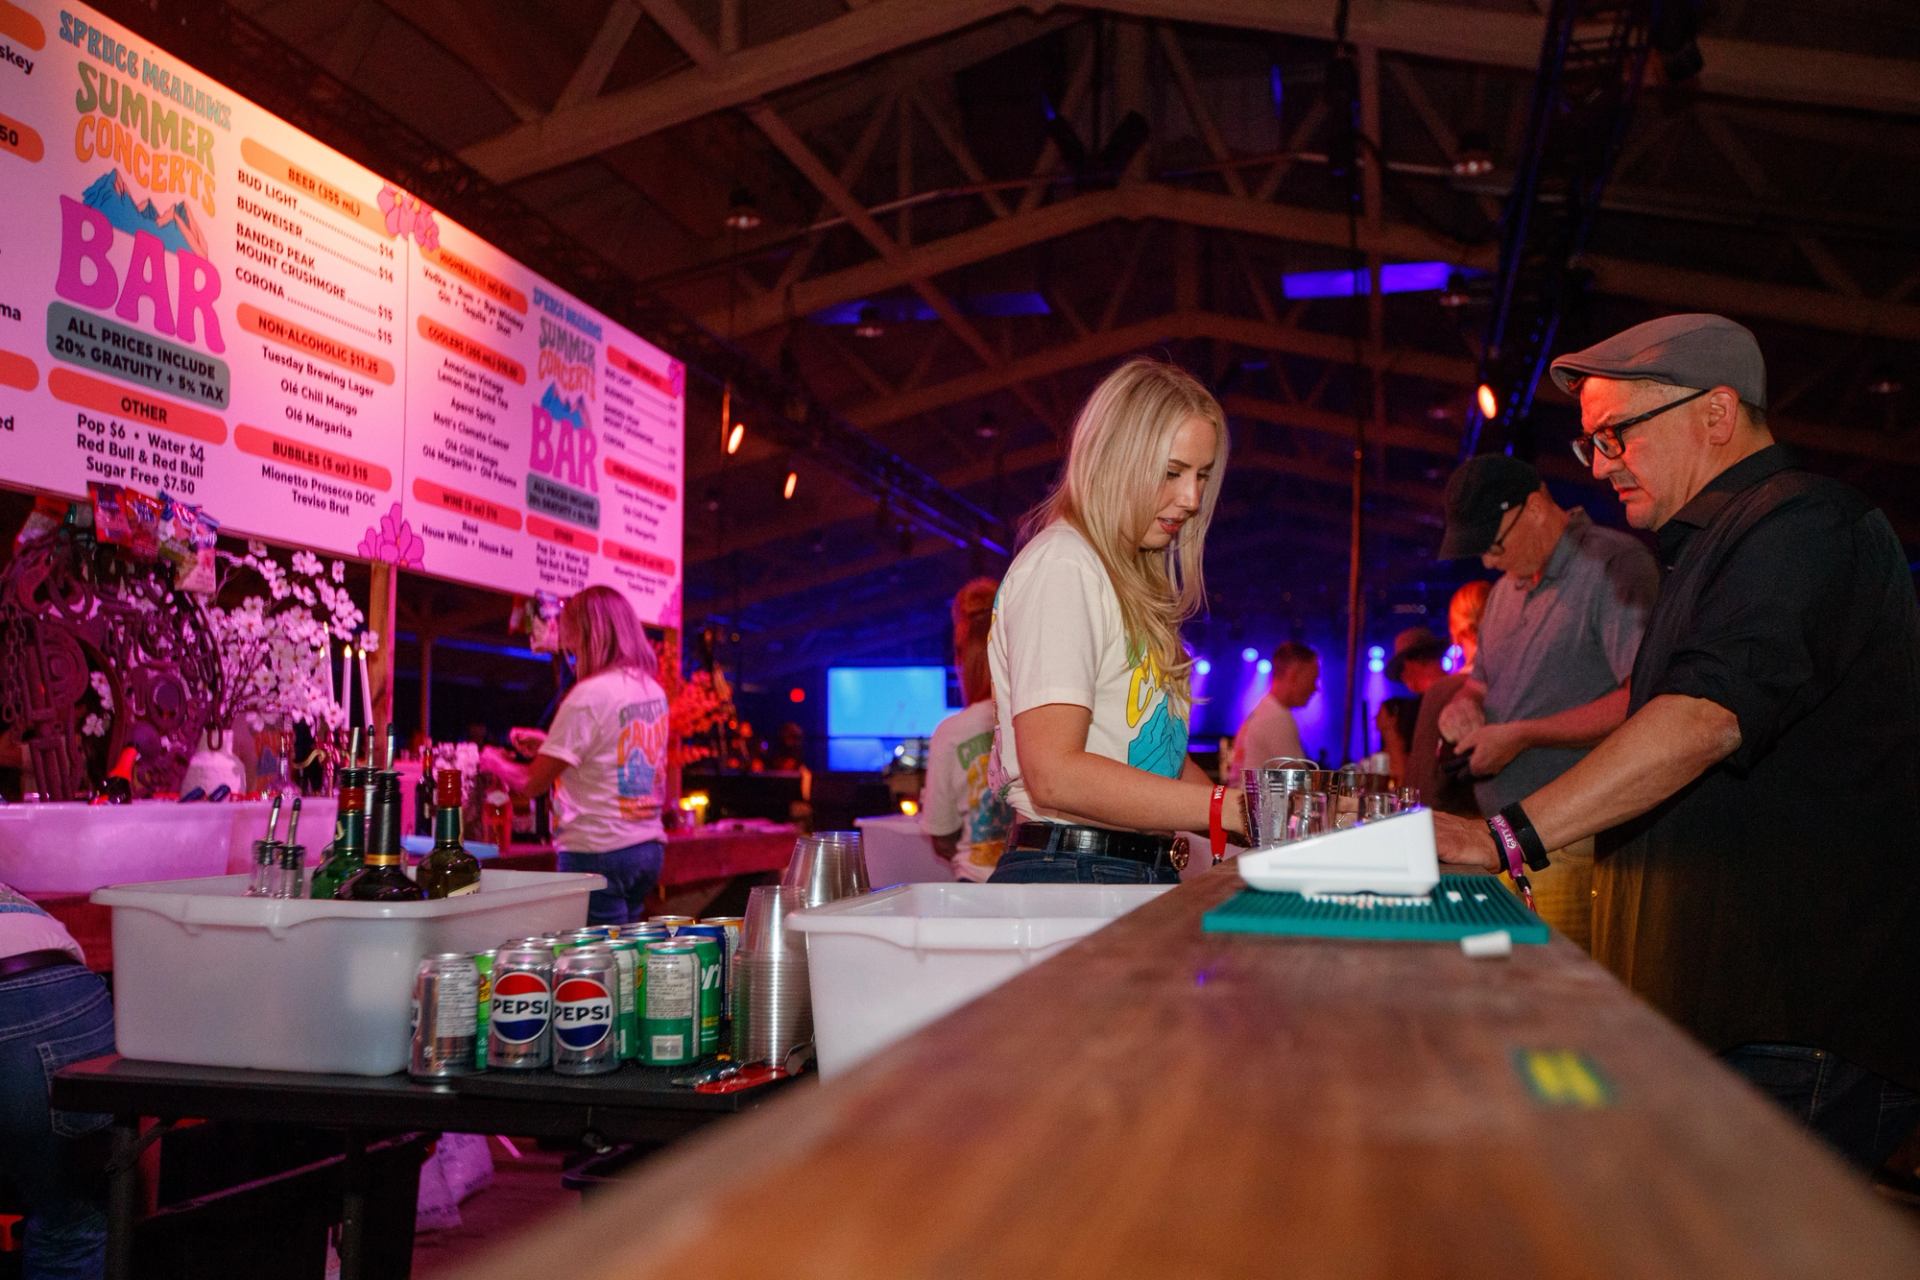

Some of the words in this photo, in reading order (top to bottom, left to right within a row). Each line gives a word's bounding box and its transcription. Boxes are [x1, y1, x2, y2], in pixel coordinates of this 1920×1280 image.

[0, 45, 34, 75] skey
[59, 10, 139, 79] SPRUCE
[142, 58, 232, 131] MEADOWS
[0, 123, 19, 146] 50
[75, 61, 215, 175] SUMMER
[75, 115, 216, 218] CONCERTS
[288, 168, 316, 190] BEER
[238, 169, 262, 192] BUD
[265, 184, 298, 210] LIGHT
[237, 196, 303, 237] BUDWEISER
[236, 222, 284, 255] BANDED
[288, 246, 315, 270] PEAK
[55, 194, 226, 354] BAR
[235, 266, 285, 298] CORONA
[236, 239, 277, 269] MOUNT
[281, 261, 346, 300] CRUSHMORE
[67, 316, 98, 341] ALL
[102, 325, 154, 359] PRICES
[157, 347, 216, 380] INCLUDE
[258, 315, 347, 362] NON-ALCOHOLIC
[539, 315, 596, 373] SUMMER
[55, 335, 87, 359] 20%
[91, 346, 162, 383] GRATUITY
[166, 374, 176, 386] +
[178, 375, 196, 394] 5%
[199, 384, 224, 404] TAX
[262, 345, 304, 374] Tuesday
[306, 362, 346, 389] Brewing
[348, 378, 374, 398] Lager
[120, 396, 168, 425] OTHER
[281, 378, 299, 395] Olé
[301, 387, 323, 404] Chili
[326, 394, 358, 416] Mango
[77, 412, 105, 436] Pop
[109, 420, 126, 440] $6
[148, 431, 187, 456] Water
[285, 405, 303, 421] Olé
[305, 413, 353, 438] Margarita
[77, 433, 105, 453] Red
[109, 440, 135, 461] Bull
[138, 448, 149, 464] &
[152, 453, 177, 472] Red
[180, 459, 205, 479] Bull
[272, 440, 320, 468] BUBBLES
[530, 402, 599, 493] BAR
[86, 455, 126, 479] Sugar
[130, 466, 160, 487] Free
[163, 475, 196, 495] $7.50
[261, 464, 308, 489] Mionetto
[311, 478, 353, 500] Prosecco
[355, 489, 376, 506] DOC
[292, 489, 327, 510] Treviso
[329, 500, 350, 516] Brut
[492, 998, 549, 1015] PEPSI
[554, 1004, 610, 1021] PEPSI
